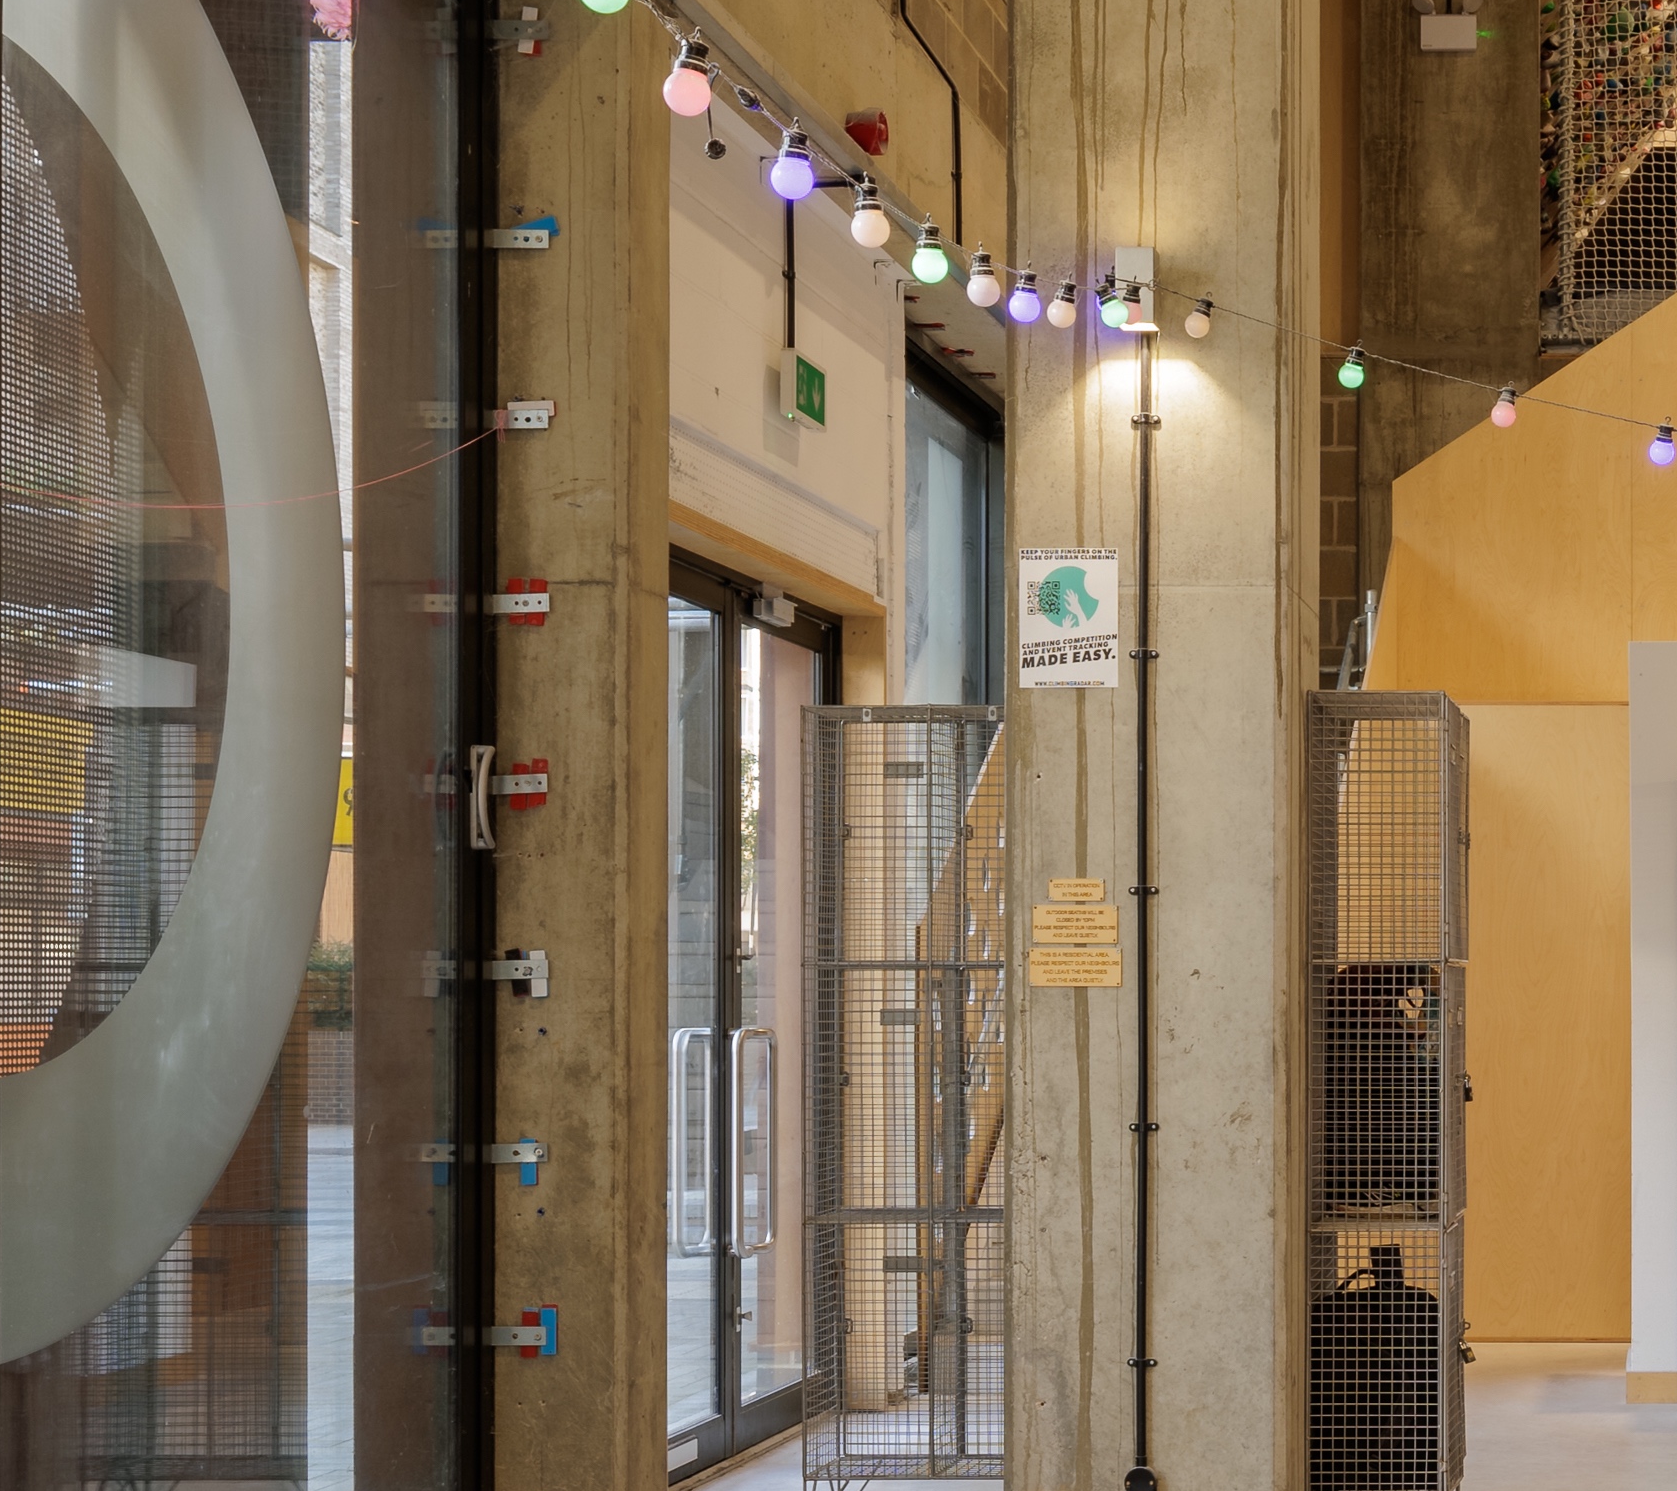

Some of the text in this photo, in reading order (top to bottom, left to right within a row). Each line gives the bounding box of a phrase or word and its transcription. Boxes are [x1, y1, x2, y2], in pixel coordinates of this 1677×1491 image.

[1022, 634, 1117, 649] CLIMBING COMPETITION
[1042, 646, 1066, 654] EVENT
[1069, 642, 1108, 650] TRACKING
[1022, 648, 1116, 668] MADE EASY.
